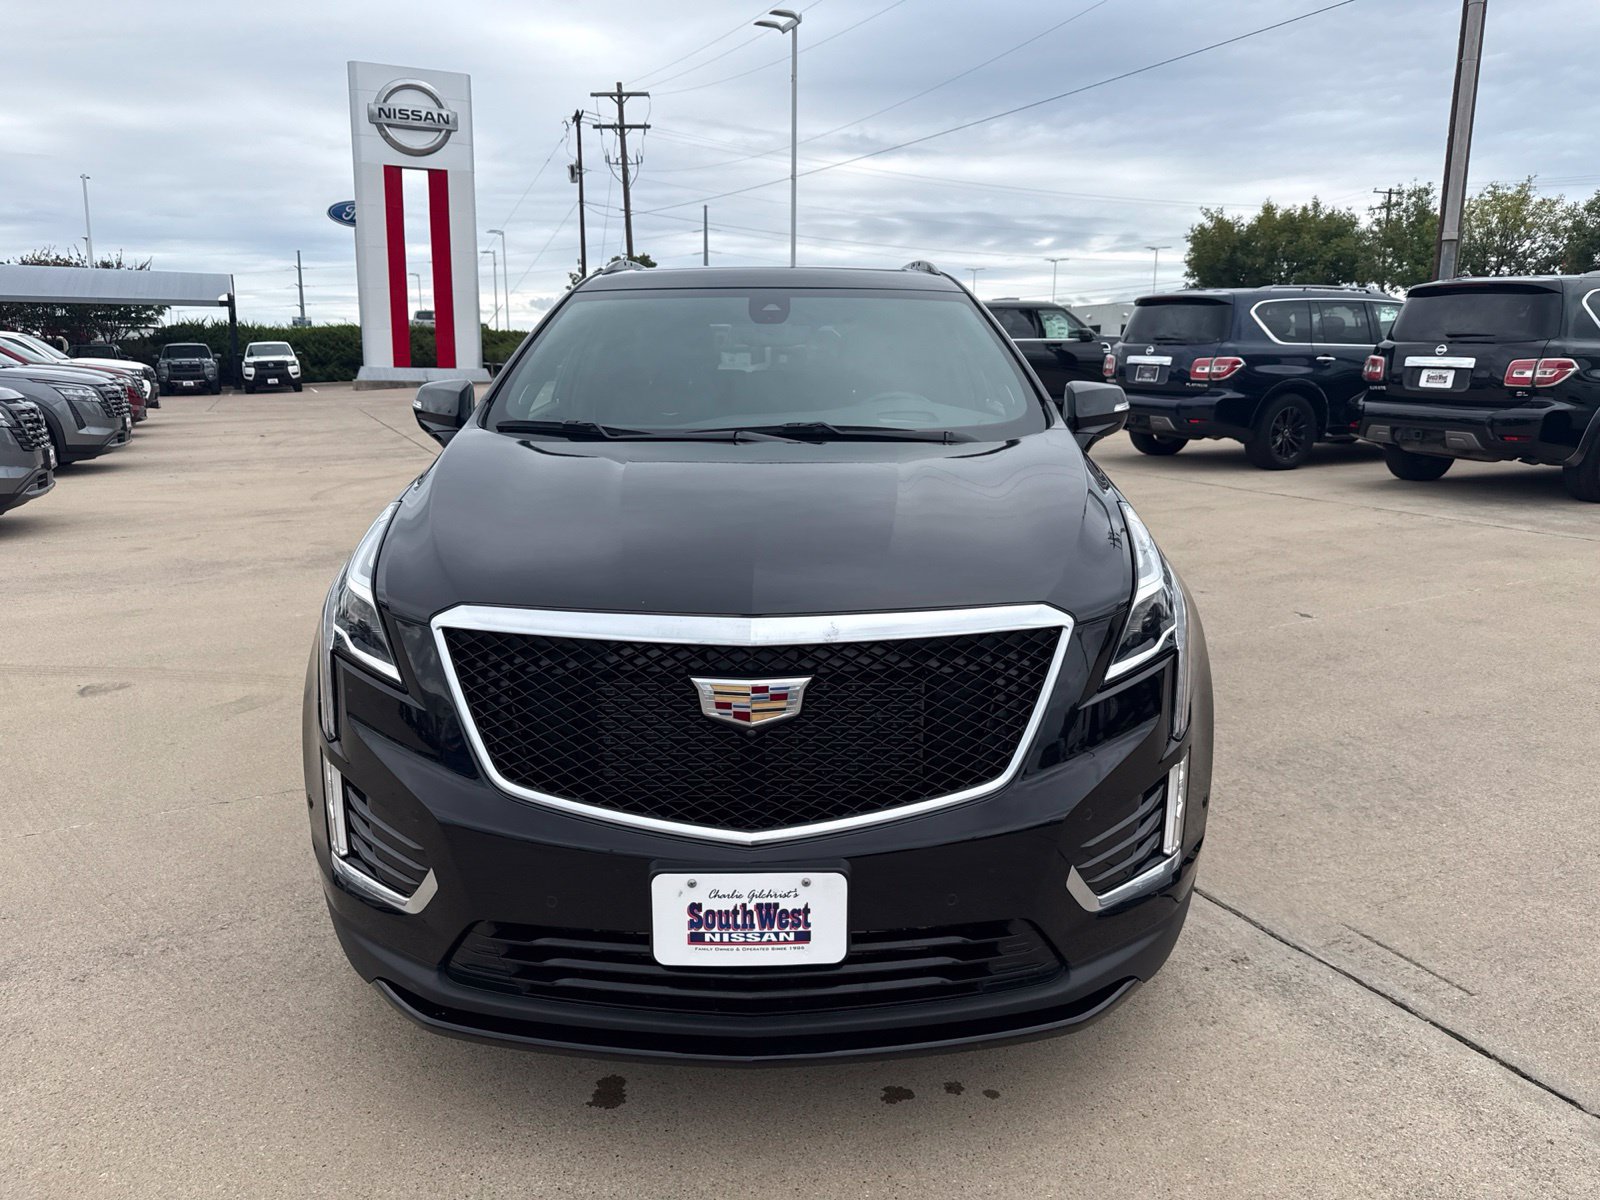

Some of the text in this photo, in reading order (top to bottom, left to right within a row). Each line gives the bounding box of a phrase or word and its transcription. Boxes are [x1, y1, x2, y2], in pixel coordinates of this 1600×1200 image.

[378, 106, 450, 125] NISSAN
[708, 888, 800, 904] Charlie Gilchrist's
[704, 932, 795, 942] NISSAN
